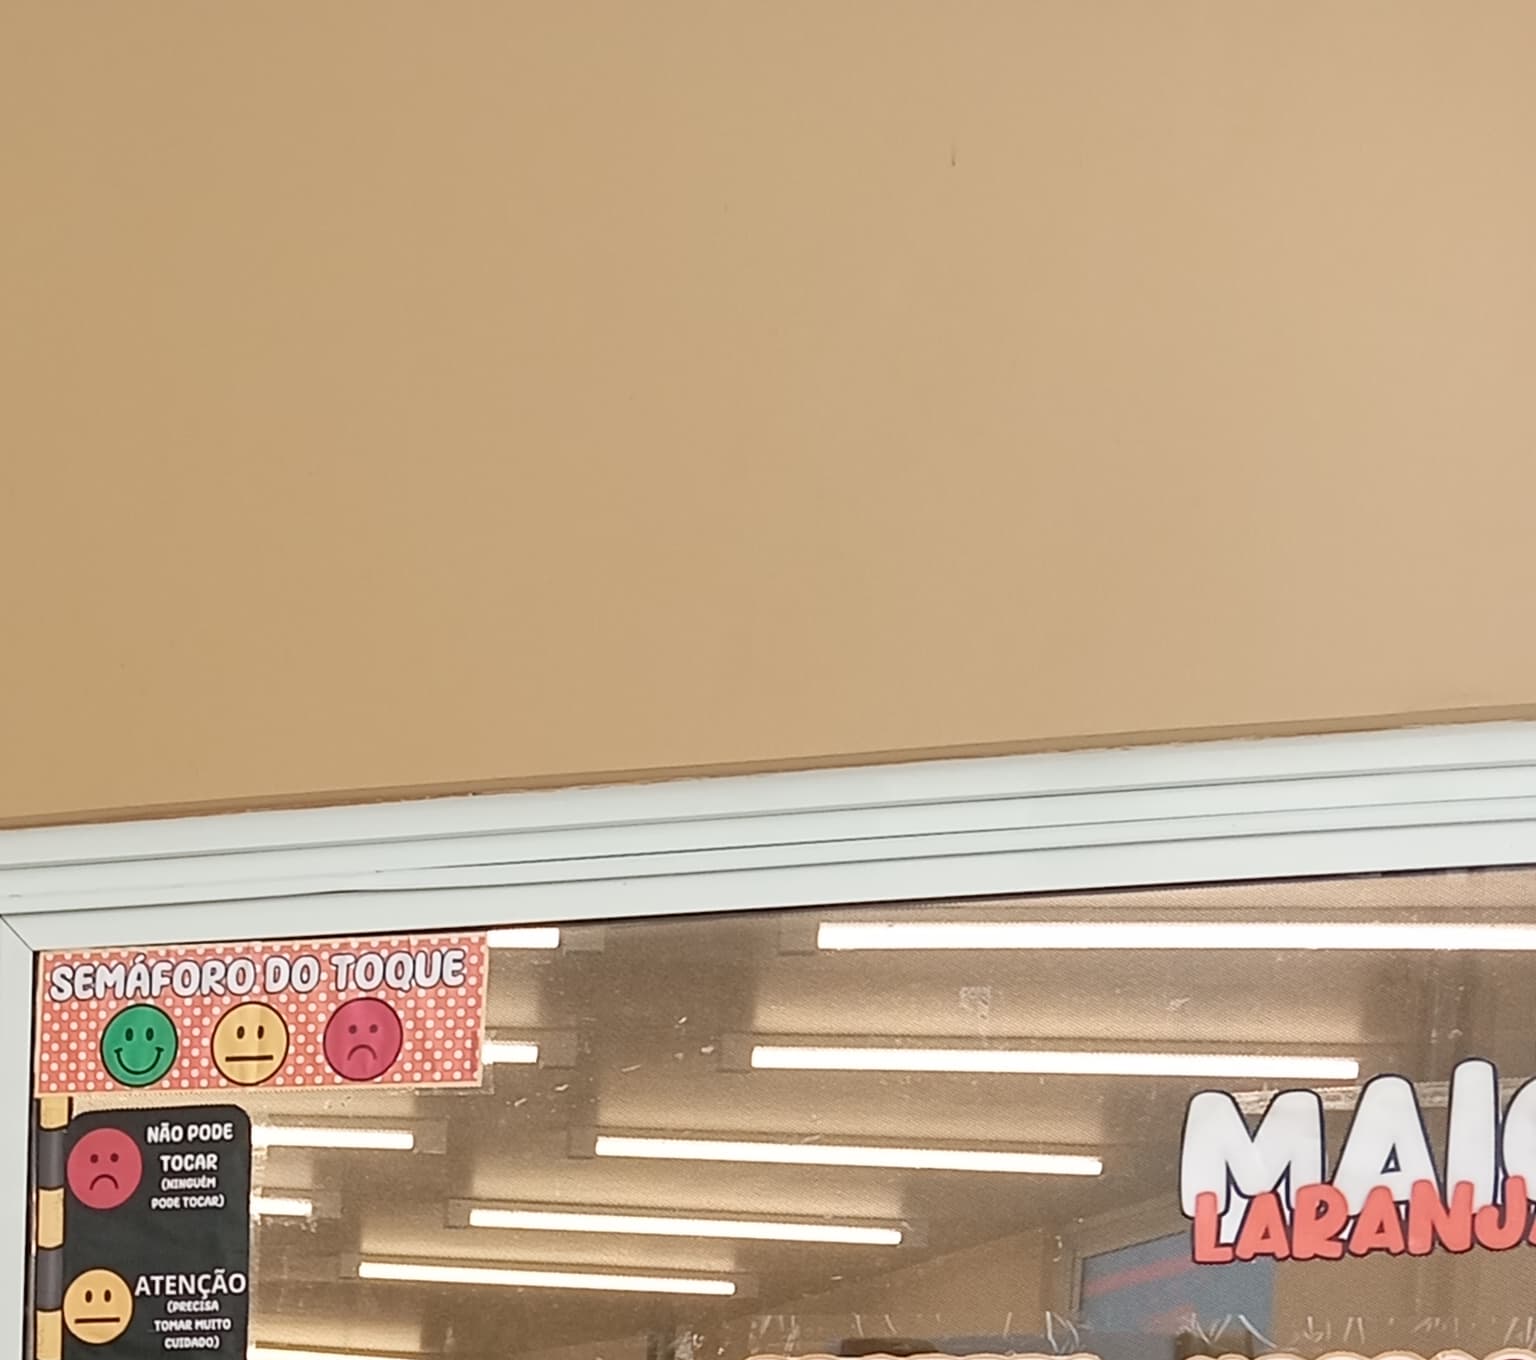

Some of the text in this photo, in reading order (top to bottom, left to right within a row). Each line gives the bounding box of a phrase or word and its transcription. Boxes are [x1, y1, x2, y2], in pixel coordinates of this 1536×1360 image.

[49, 949, 465, 1001] SEMÁFORO DO TOQUE
[147, 1123, 234, 1143] NÃO PODE
[160, 1154, 218, 1172] TOCAR
[151, 1194, 225, 1210] PODE TOCAR)
[1192, 1176, 1536, 1263] LARANJ
[134, 1269, 247, 1300] ATENÇÃO
[166, 1300, 220, 1313] (PRECISA
[154, 1318, 232, 1332] TOMAR MUITO
[164, 1336, 220, 1349] CUIDADO)
